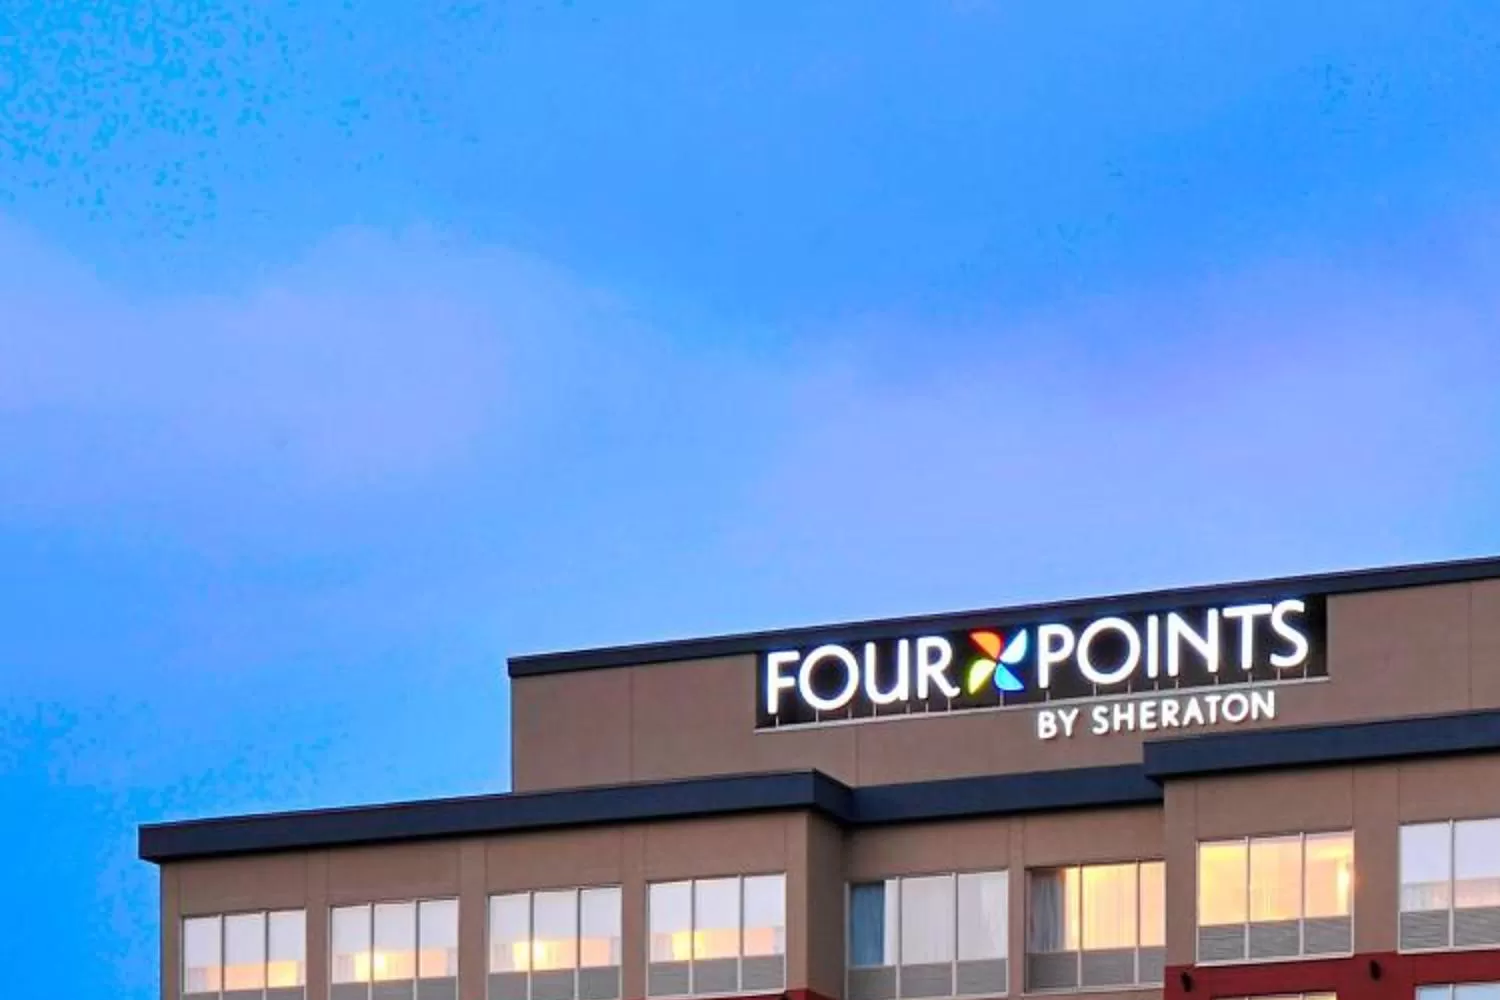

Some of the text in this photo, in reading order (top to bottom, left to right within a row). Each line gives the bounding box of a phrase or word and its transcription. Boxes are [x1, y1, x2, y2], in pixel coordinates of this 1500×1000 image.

[766, 599, 1310, 714] FOUR POINTS
[1036, 690, 1276, 739] BY SHERATON
